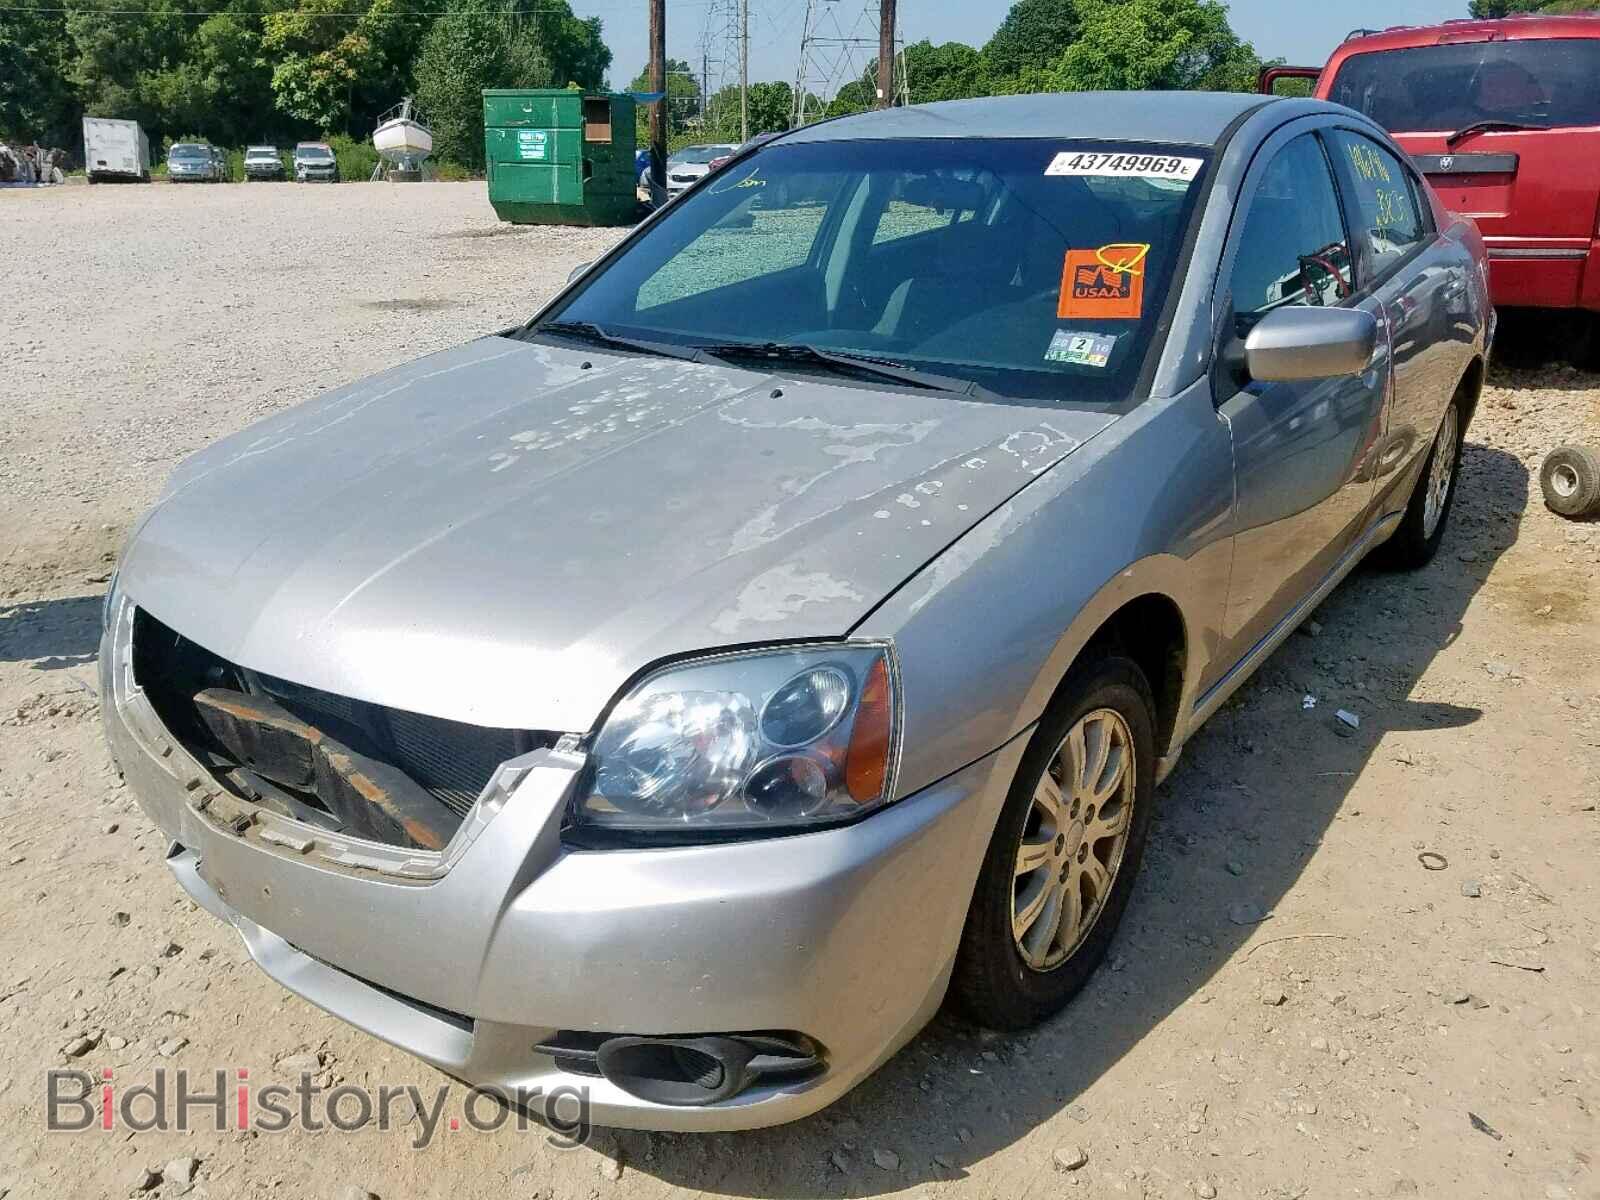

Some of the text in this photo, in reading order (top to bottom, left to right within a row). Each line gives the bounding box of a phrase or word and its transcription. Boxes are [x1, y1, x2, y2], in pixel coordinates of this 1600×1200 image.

[1068, 153, 1181, 174] 43749969
[1075, 287, 1121, 298] USAA
[1075, 338, 1087, 350] 2
